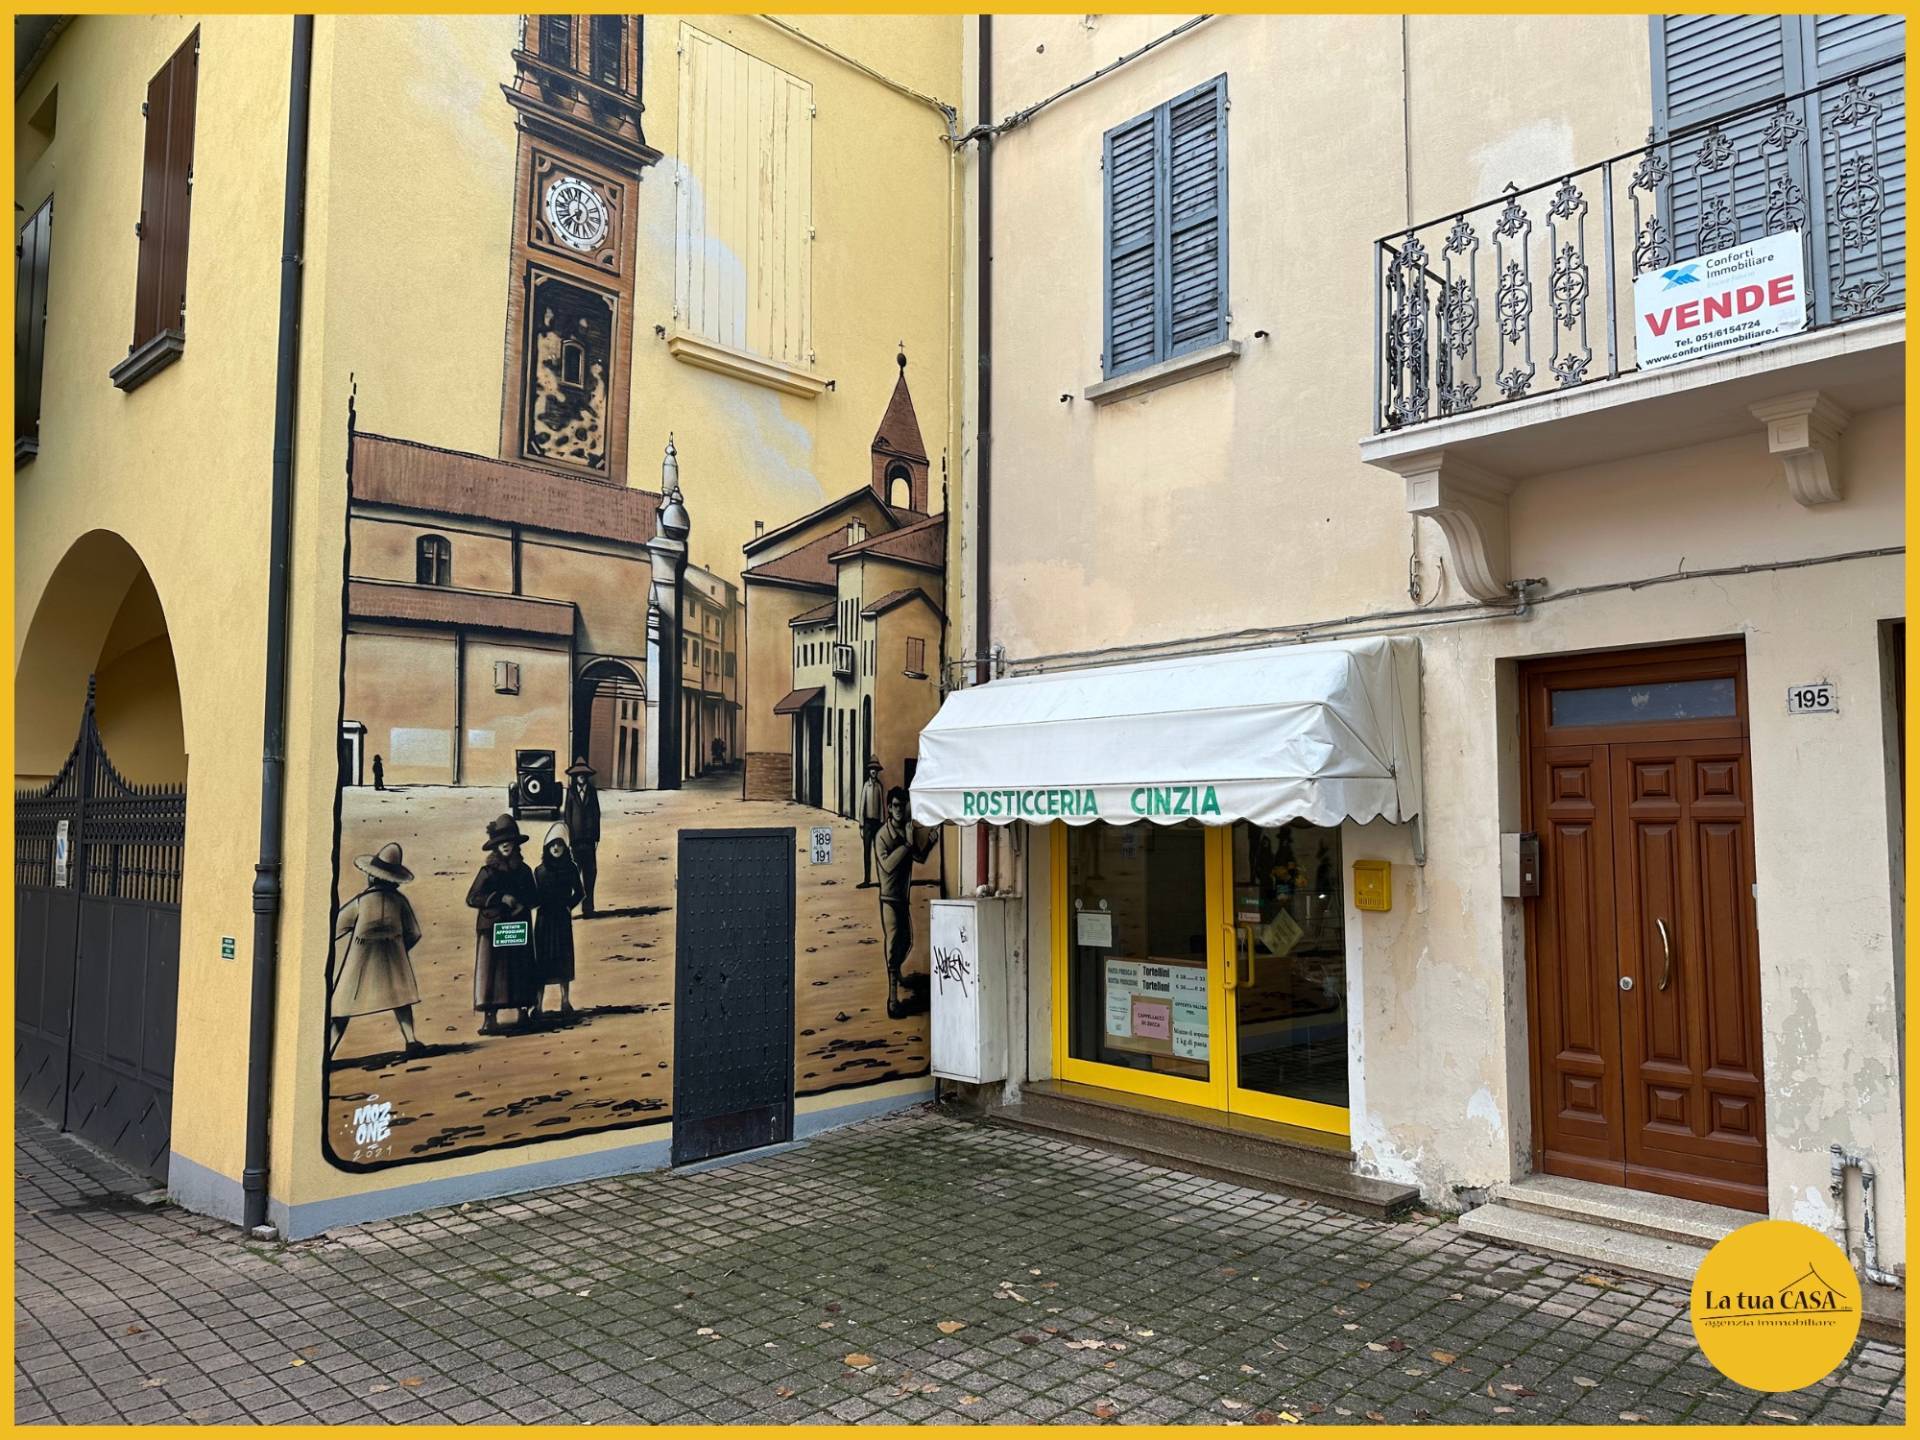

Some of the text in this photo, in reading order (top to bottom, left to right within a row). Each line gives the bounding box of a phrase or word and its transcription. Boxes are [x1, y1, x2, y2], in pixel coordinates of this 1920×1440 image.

[1706, 248, 1754, 269] Conforti
[1706, 254, 1775, 279] Immobiliare
[1644, 274, 1796, 337] VENDE
[1675, 320, 1761, 348] Tel. 051/6154724
[1794, 688, 1830, 708] 195
[963, 785, 1222, 816] ROSTICCERIA CINZIA
[815, 833, 832, 845] 189
[815, 850, 831, 862] 191
[1142, 965, 1170, 978] Tortellini
[1142, 979, 1170, 992] Tortelloni
[353, 1101, 392, 1126] MOZ
[356, 1121, 391, 1145] ONE
[352, 1145, 392, 1162] 2021
